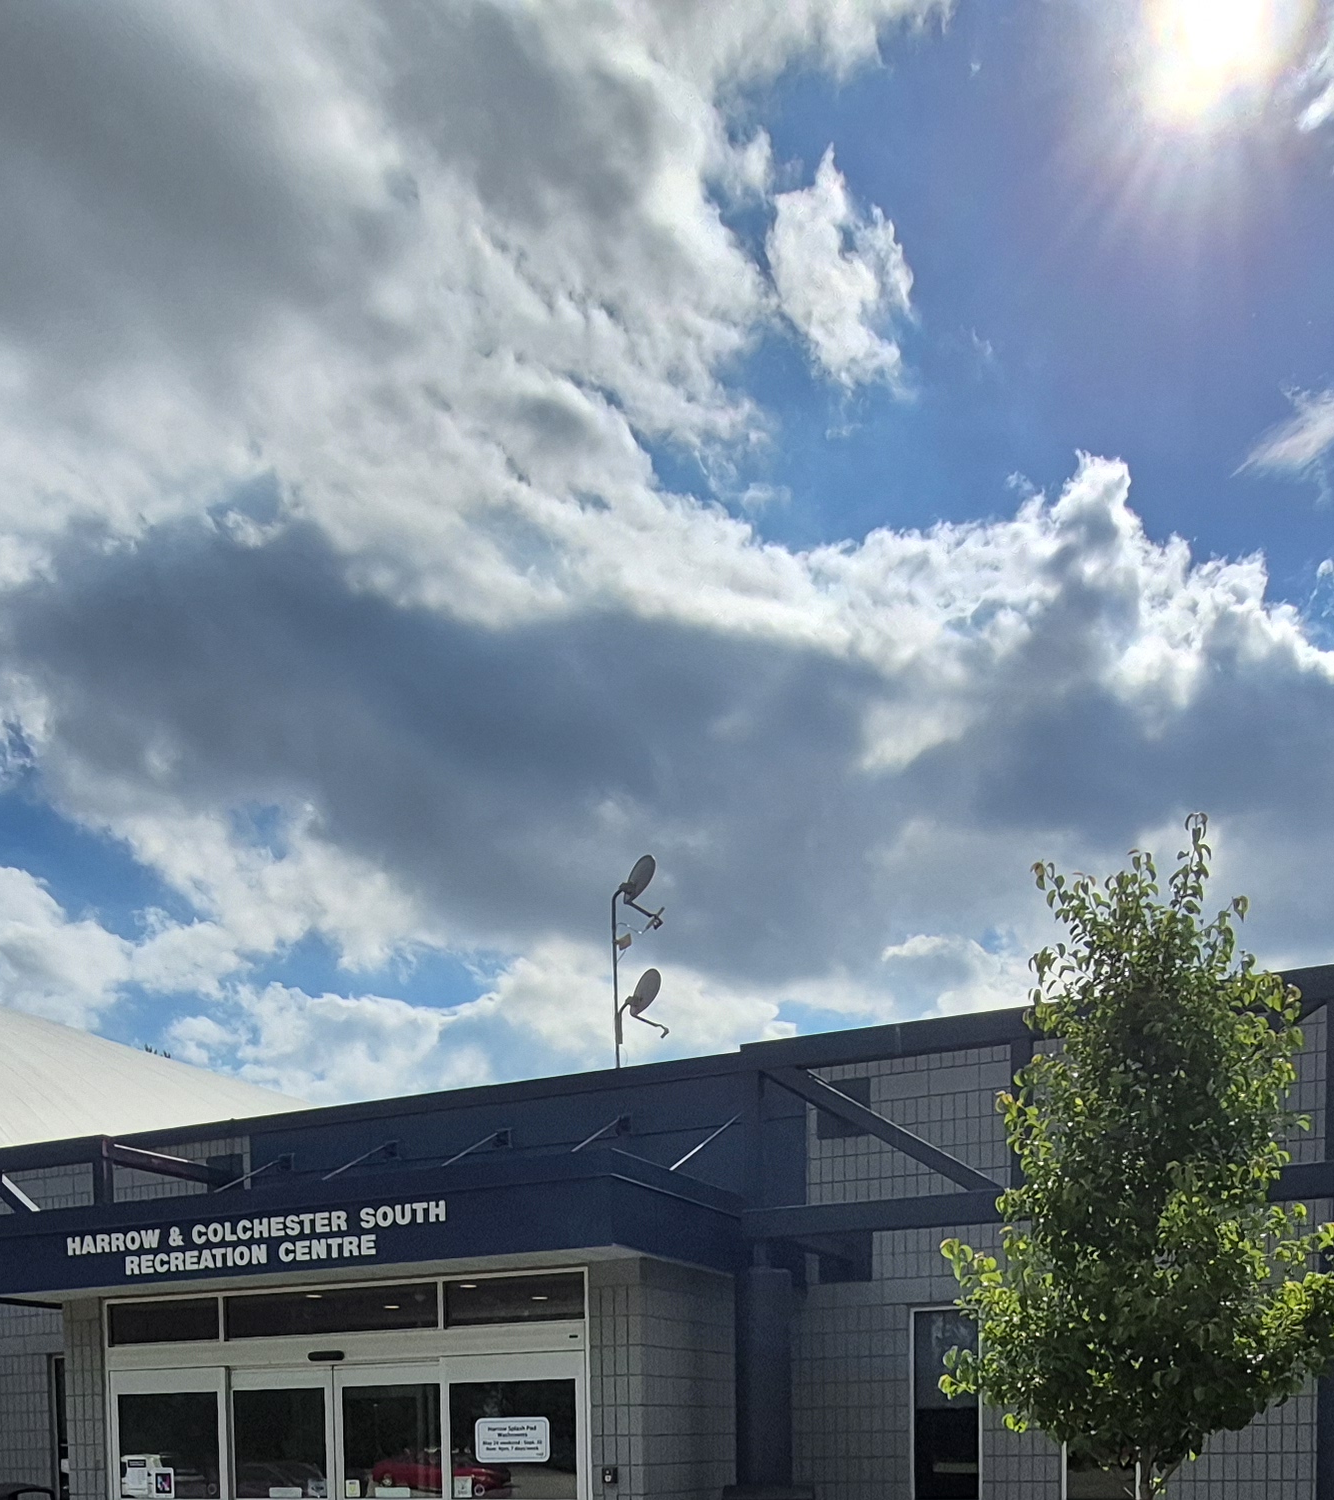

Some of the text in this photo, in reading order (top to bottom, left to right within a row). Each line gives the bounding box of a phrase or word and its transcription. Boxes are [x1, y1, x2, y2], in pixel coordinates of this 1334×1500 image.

[66, 1199, 447, 1257] HARROW & COLCHESTER SOUTH
[125, 1234, 377, 1276] RECREATION CENTRE
